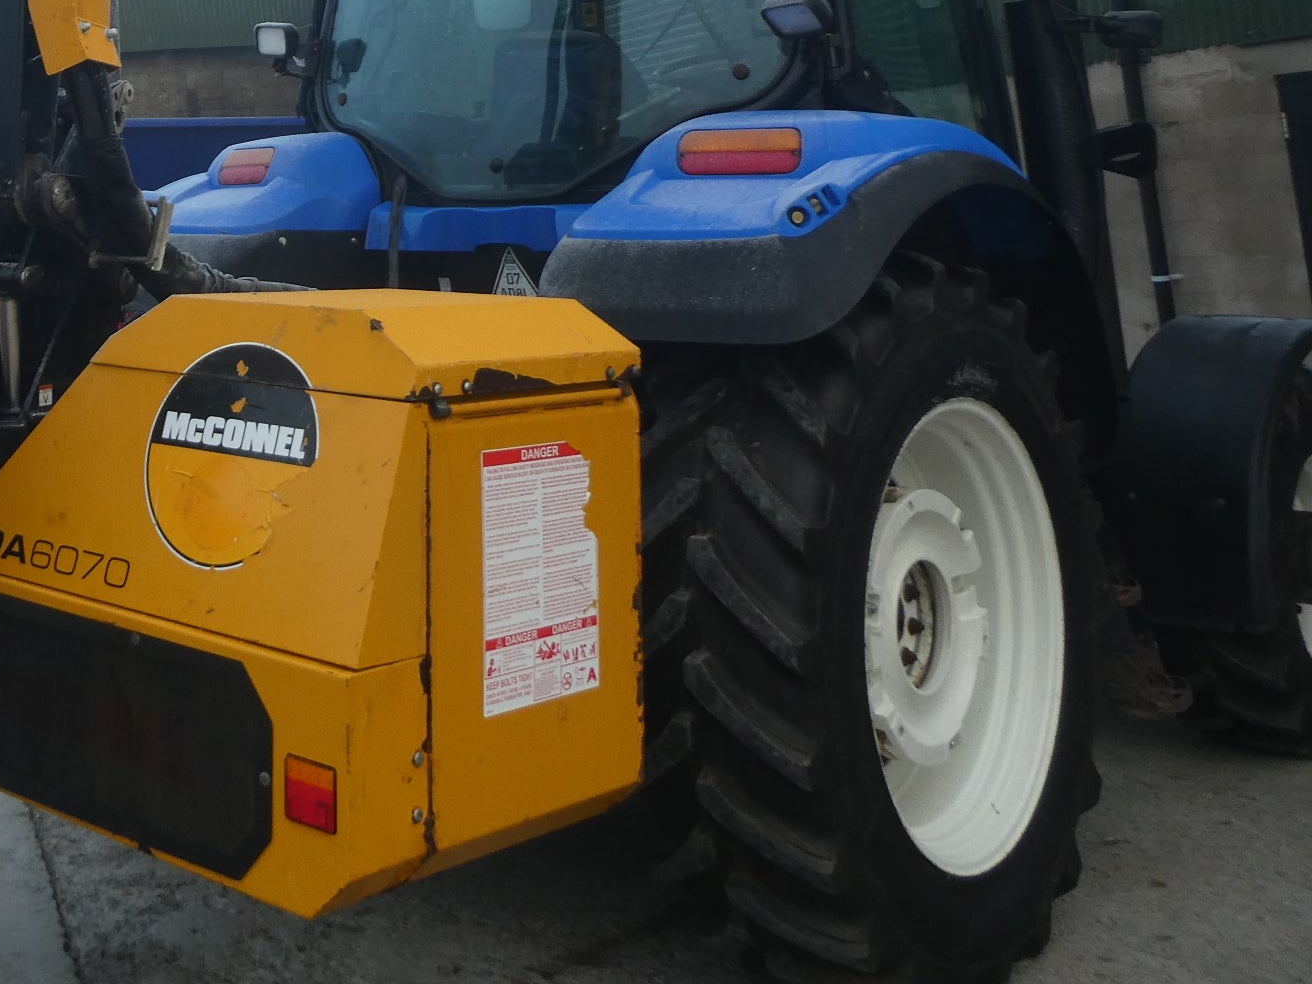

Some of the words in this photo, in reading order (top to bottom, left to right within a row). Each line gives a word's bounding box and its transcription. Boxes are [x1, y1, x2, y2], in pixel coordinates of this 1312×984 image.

[520, 445, 559, 460] DANGER
[551, 619, 583, 635] DANGER
[505, 629, 538, 646] DANGER
